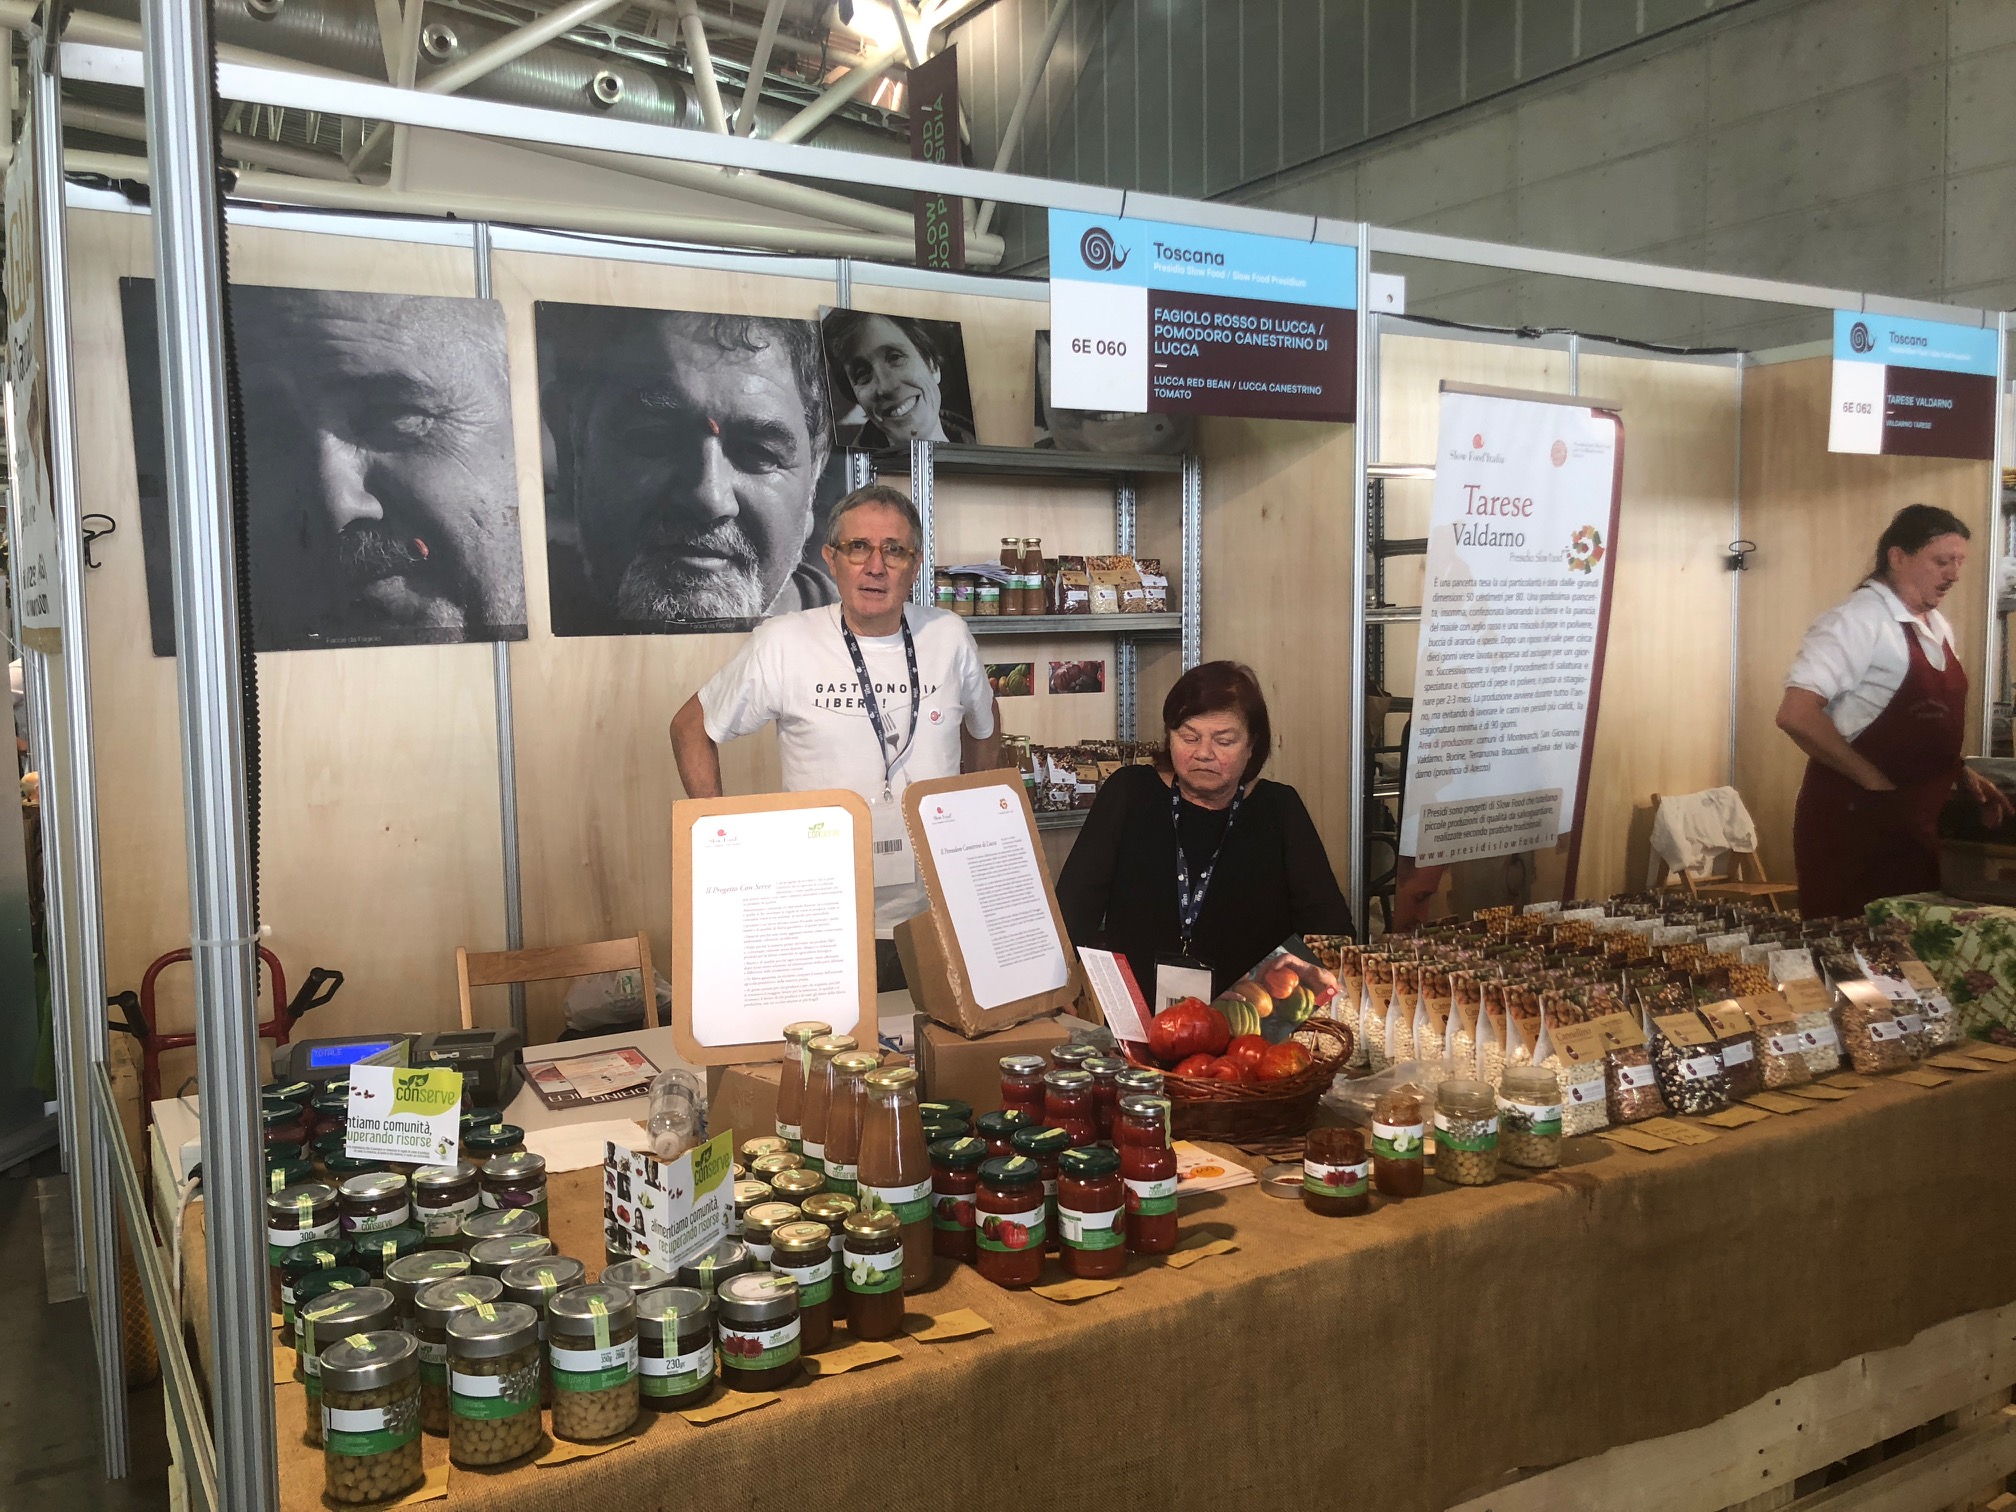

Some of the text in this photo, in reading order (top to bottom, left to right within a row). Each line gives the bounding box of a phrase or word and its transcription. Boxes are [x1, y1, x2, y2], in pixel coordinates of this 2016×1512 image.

[939, 222, 950, 268] OD
[1153, 242, 1225, 266] Toscana
[1153, 262, 1185, 275] Presidio
[1186, 265, 1205, 276] Slow
[1206, 267, 1225, 279] Food
[1232, 270, 1251, 281] Slow
[1252, 272, 1270, 284] Food
[1271, 274, 1307, 288] Presidium
[1154, 308, 1324, 335] FAGIOLO ROSSO DI LUCCA /
[1072, 338, 1127, 356] 6E 060
[1154, 326, 1328, 351] POMODORO CANESTRINO DI
[1889, 331, 1928, 347] Toscana
[1154, 342, 1199, 357] LUCCA
[1153, 375, 1185, 386] LUCCA
[1186, 377, 1205, 388] RED
[1207, 378, 1231, 390] BEAN
[1238, 381, 1267, 392] LUCCA
[1269, 383, 1322, 395] CANESTRINO
[1153, 389, 1192, 400] TOMATO
[1887, 394, 1953, 409] TARESE VALDARNO
[1842, 401, 1872, 415] 6E 062
[1463, 484, 1534, 517] Tarese
[1452, 522, 1525, 548] Valdarno
[1452, 579, 1477, 589] pancetta
[1560, 578, 1575, 587] dalle
[1577, 579, 1599, 589] grandi
[815, 683, 937, 694] GASTONOIA
[815, 698, 886, 709] LIBER!
[1420, 726, 1455, 737] stagionatura
[1457, 722, 1478, 732] minima
[1491, 720, 1498, 729] 90
[1418, 741, 1431, 749] Area
[1433, 739, 1439, 748] di
[1441, 738, 1473, 749] produzione:
[1477, 736, 1496, 744] comuni
[1541, 730, 1549, 738] San
[1552, 729, 1580, 737] Giovanni
[1417, 755, 1443, 764] Valdarno,
[1446, 752, 1466, 761] Bucine,
[1469, 749, 1499, 759] Terranuova
[1553, 742, 1562, 750] del
[1566, 742, 1578, 750] Val-
[1415, 763, 1491, 779] darno (provincia di Arezzo)
[1427, 807, 1448, 818] Presidi
[1464, 803, 1487, 814] progetti
[1489, 802, 1495, 810] di
[1496, 800, 1510, 809] Slow
[1512, 799, 1525, 807] Food
[1424, 821, 1446, 833] piccole
[1448, 816, 1478, 829] produzioni
[1480, 814, 1486, 823] di
[1487, 811, 1507, 824] qualità
[1508, 812, 1516, 820] da
[1434, 832, 1462, 842] realizzate
[1463, 828, 1488, 838] secondo
[1489, 824, 1513, 836] pratiche
[713, 886, 738, 895] Progetto
[1556, 1028, 1592, 1041] Cannellino
[314, 1049, 342, 1057] TOTALE
[396, 1086, 455, 1106] conserve
[384, 1120, 432, 1136] comunità,
[397, 1133, 431, 1148] risorse
[694, 1152, 731, 1187] conserve
[361, 1218, 393, 1231] conserve
[650, 1195, 719, 1240] alimentiamo comunità,
[658, 1225, 698, 1255] recuperando
[699, 1213, 720, 1236] risorse
